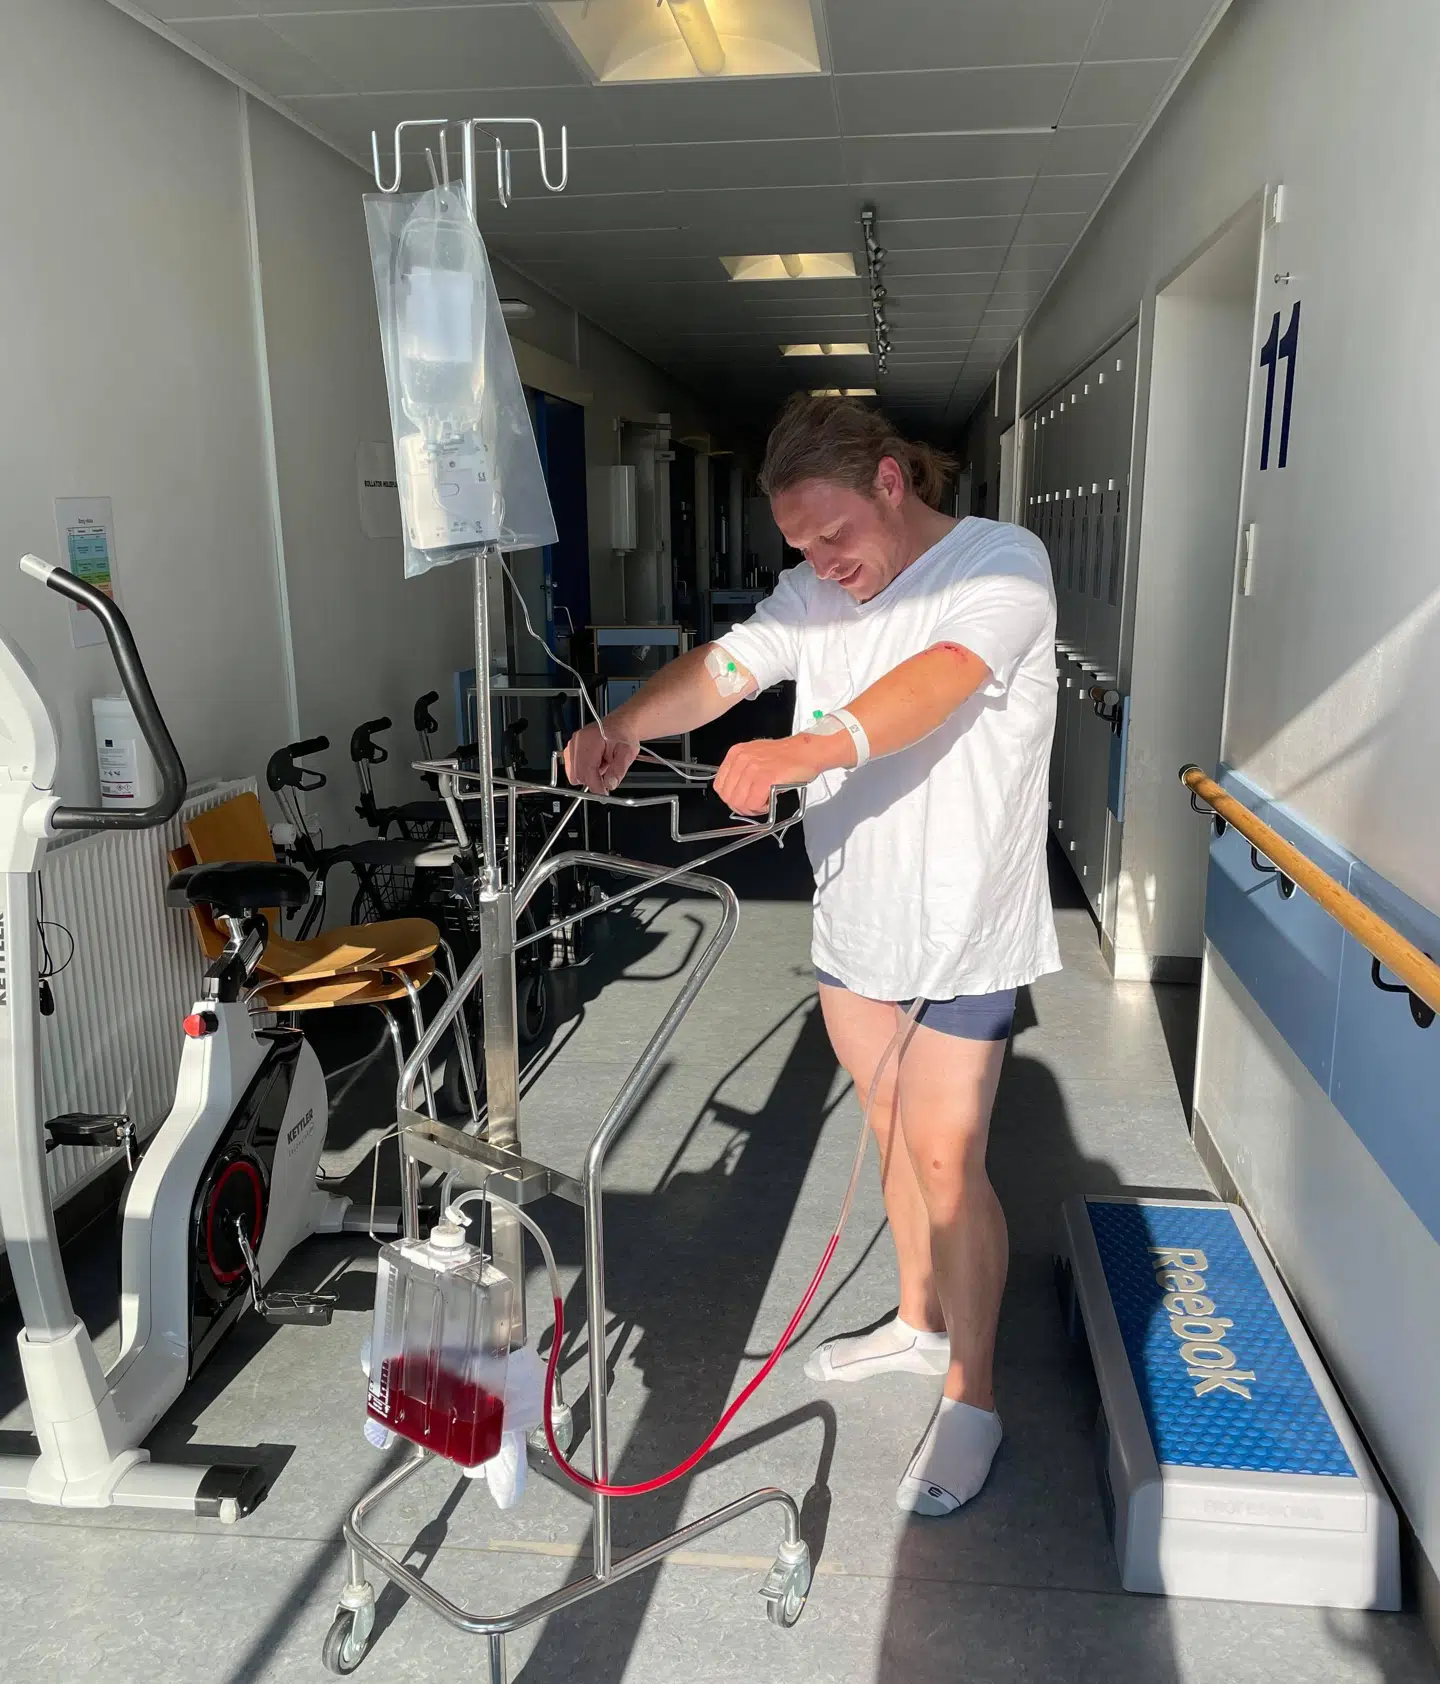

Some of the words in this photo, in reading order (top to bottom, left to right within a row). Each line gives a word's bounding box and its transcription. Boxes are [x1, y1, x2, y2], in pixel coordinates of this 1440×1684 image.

[1260, 300, 1301, 470] 11
[287, 1108, 314, 1145] KETTLER
[1147, 1246, 1256, 1400] Reebok
